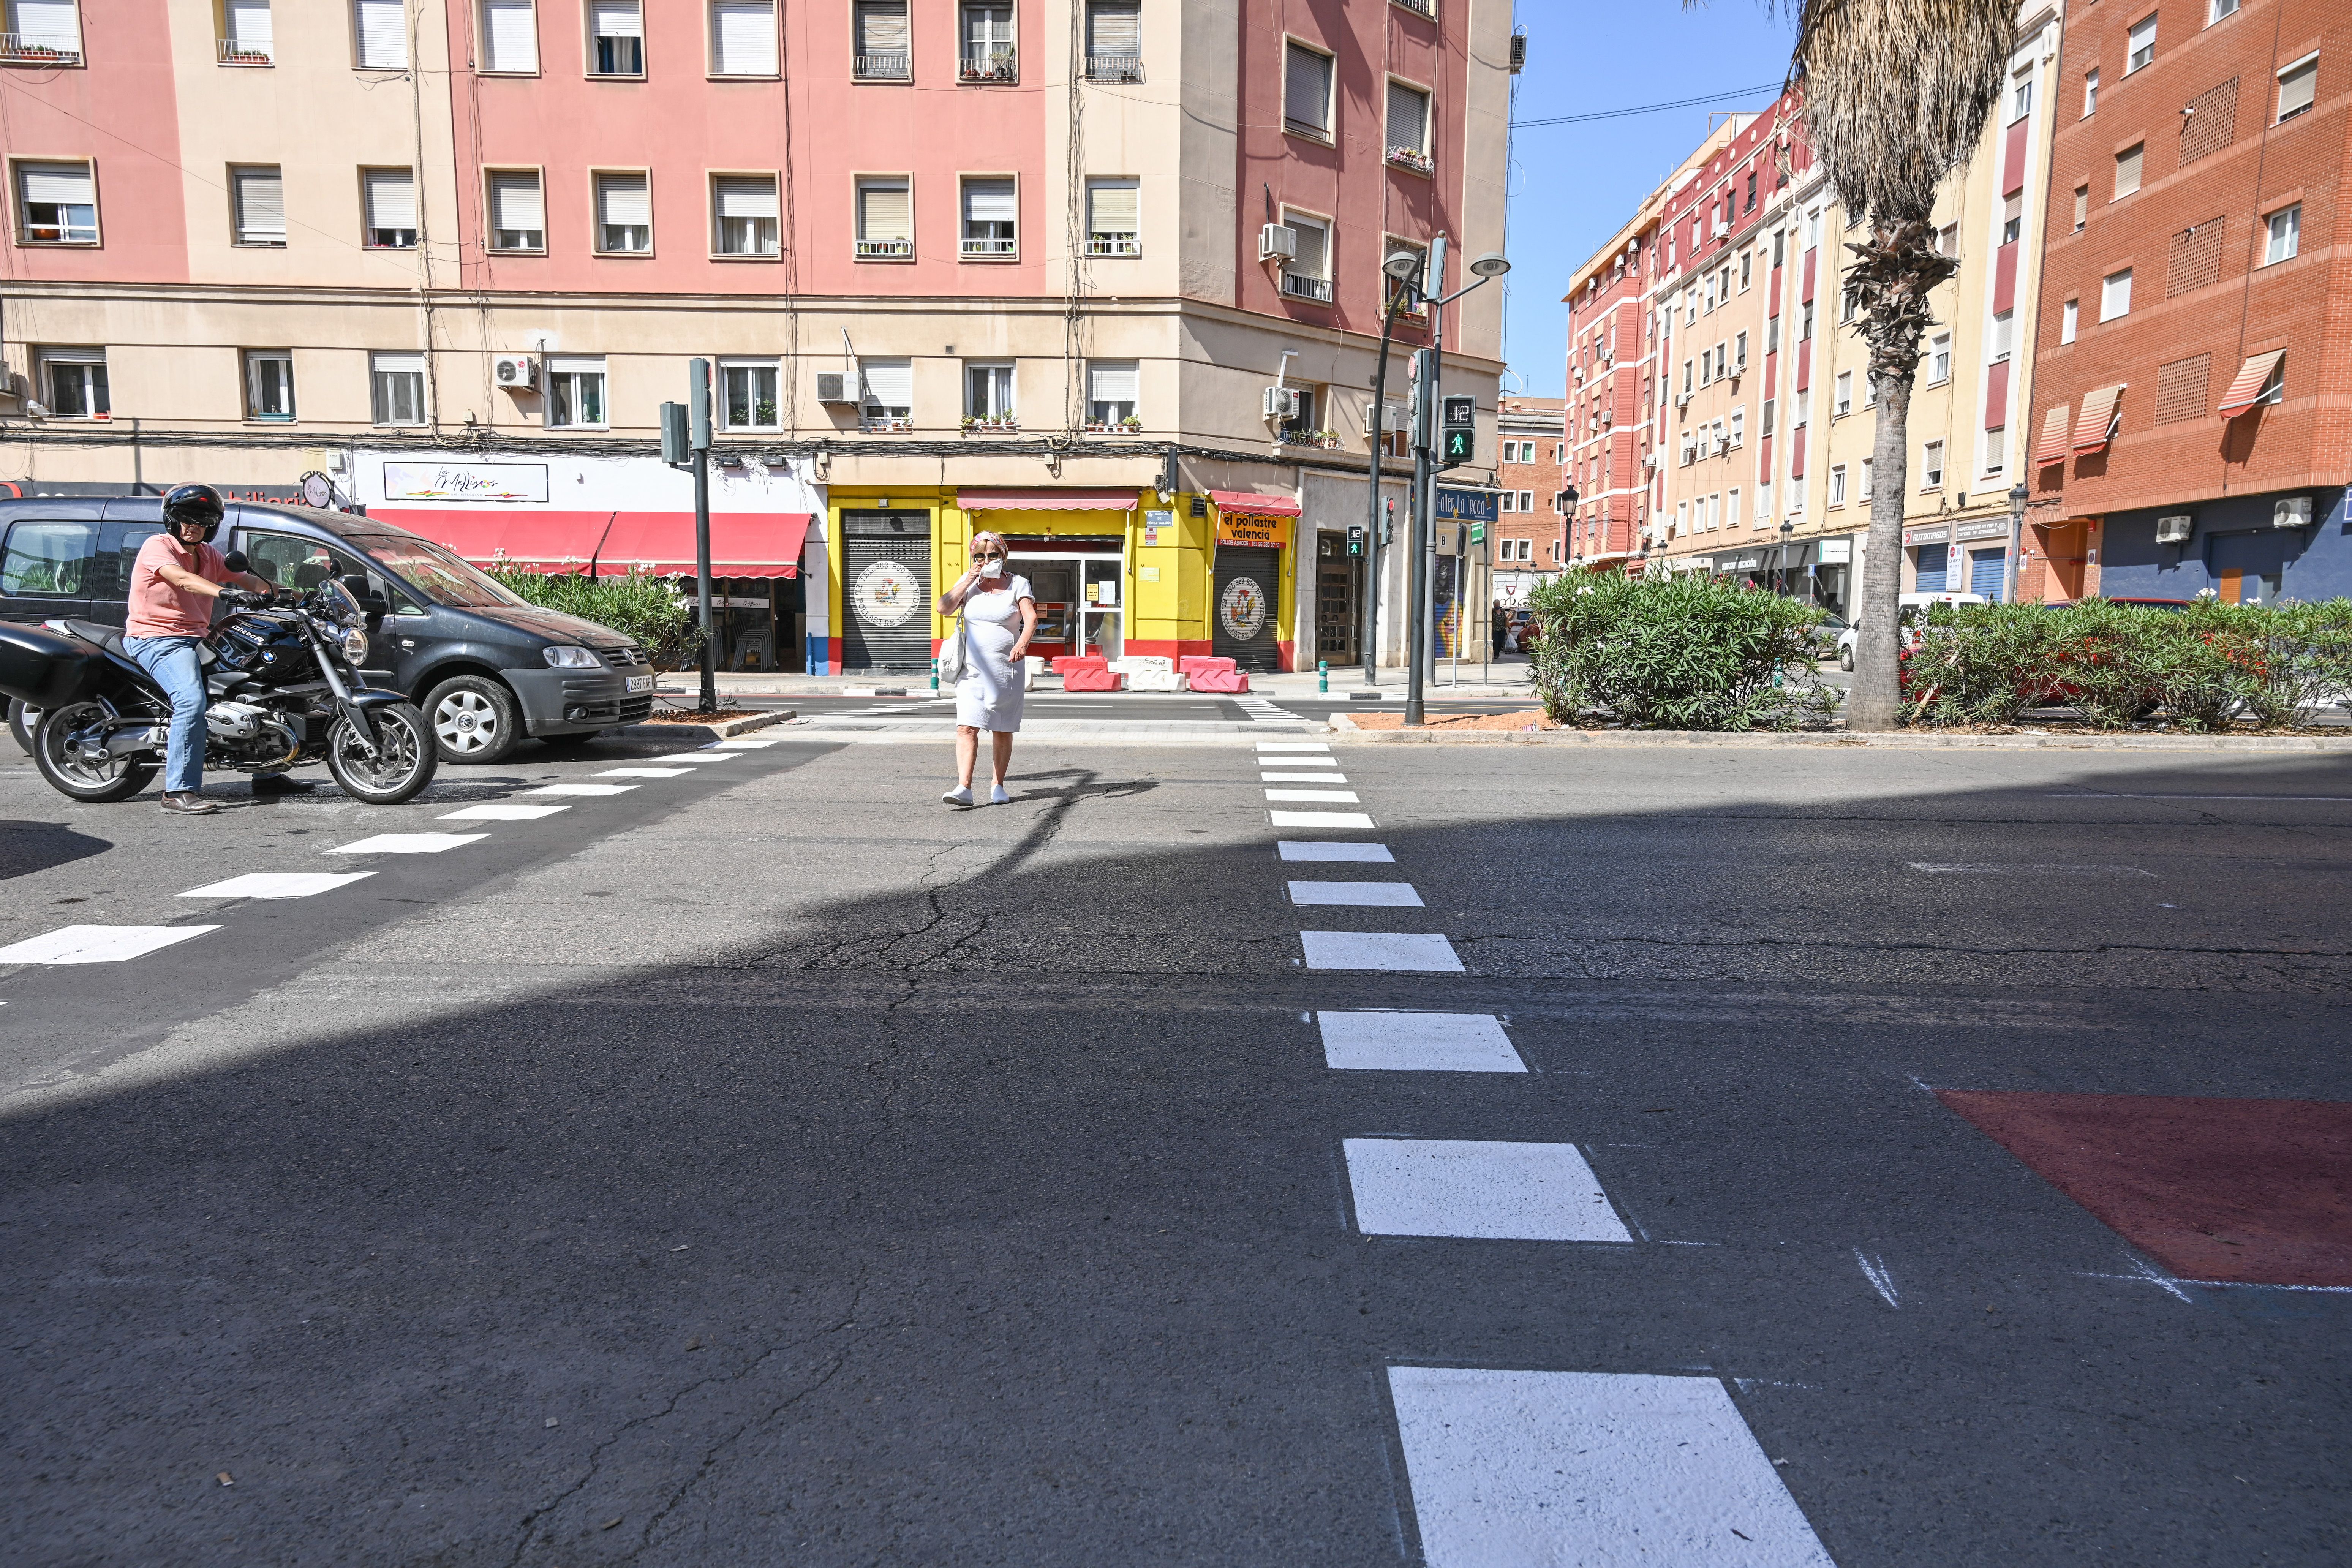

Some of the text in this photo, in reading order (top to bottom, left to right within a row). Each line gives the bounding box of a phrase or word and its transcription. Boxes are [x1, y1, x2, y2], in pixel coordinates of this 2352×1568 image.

[1455, 405, 1469, 420] 12
[436, 465, 450, 477] Los
[1457, 495, 1465, 514] La
[1224, 514, 1277, 529] el pollastre
[1231, 528, 1269, 540] valenciá
[1912, 531, 1947, 541] AUTOMAGOS
[1441, 536, 1446, 545] B
[892, 564, 905, 573] 800
[1246, 579, 1255, 588] 800
[855, 585, 920, 626] EL POLLASTRE VALENCIA
[1222, 598, 1265, 639] EL POLLASTRE VALENCIA
[631, 678, 642, 690] 2887
